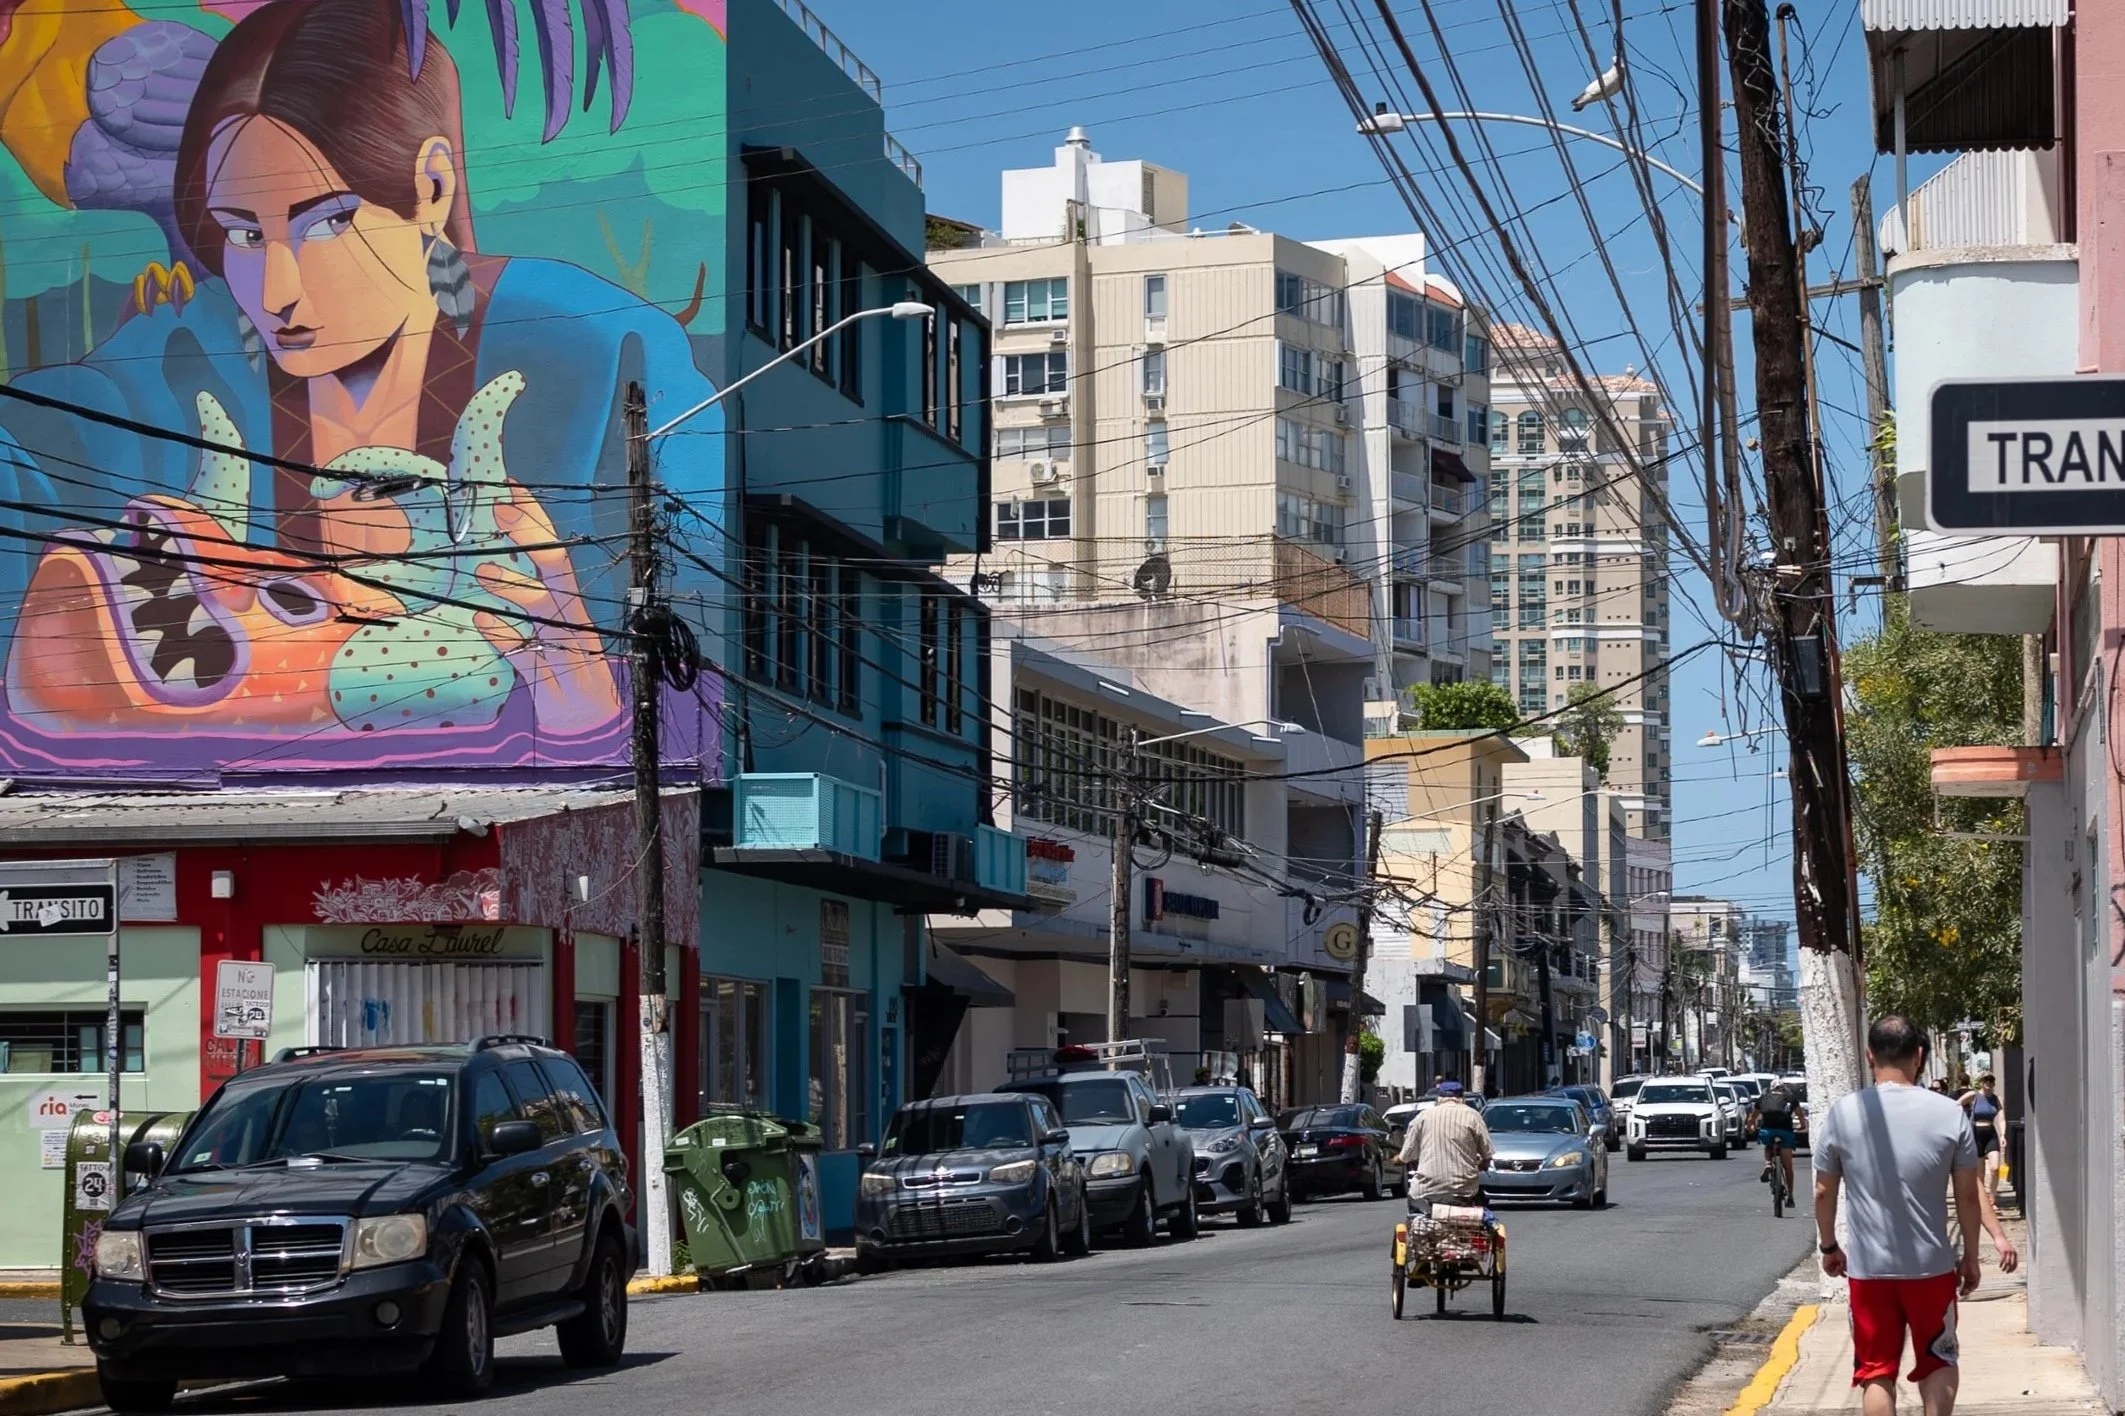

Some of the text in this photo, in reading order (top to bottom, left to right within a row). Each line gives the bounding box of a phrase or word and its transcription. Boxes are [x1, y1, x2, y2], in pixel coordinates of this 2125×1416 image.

[1987, 430, 2125, 484] TRAN
[13, 899, 99, 919] TRASITO
[361, 928, 505, 955] Casa Laurel
[1334, 930, 1351, 950] G
[238, 969, 255, 984] NO
[221, 988, 269, 1000] ESTACIONE
[40, 1096, 67, 1115] ria
[85, 1177, 104, 1192] 24
